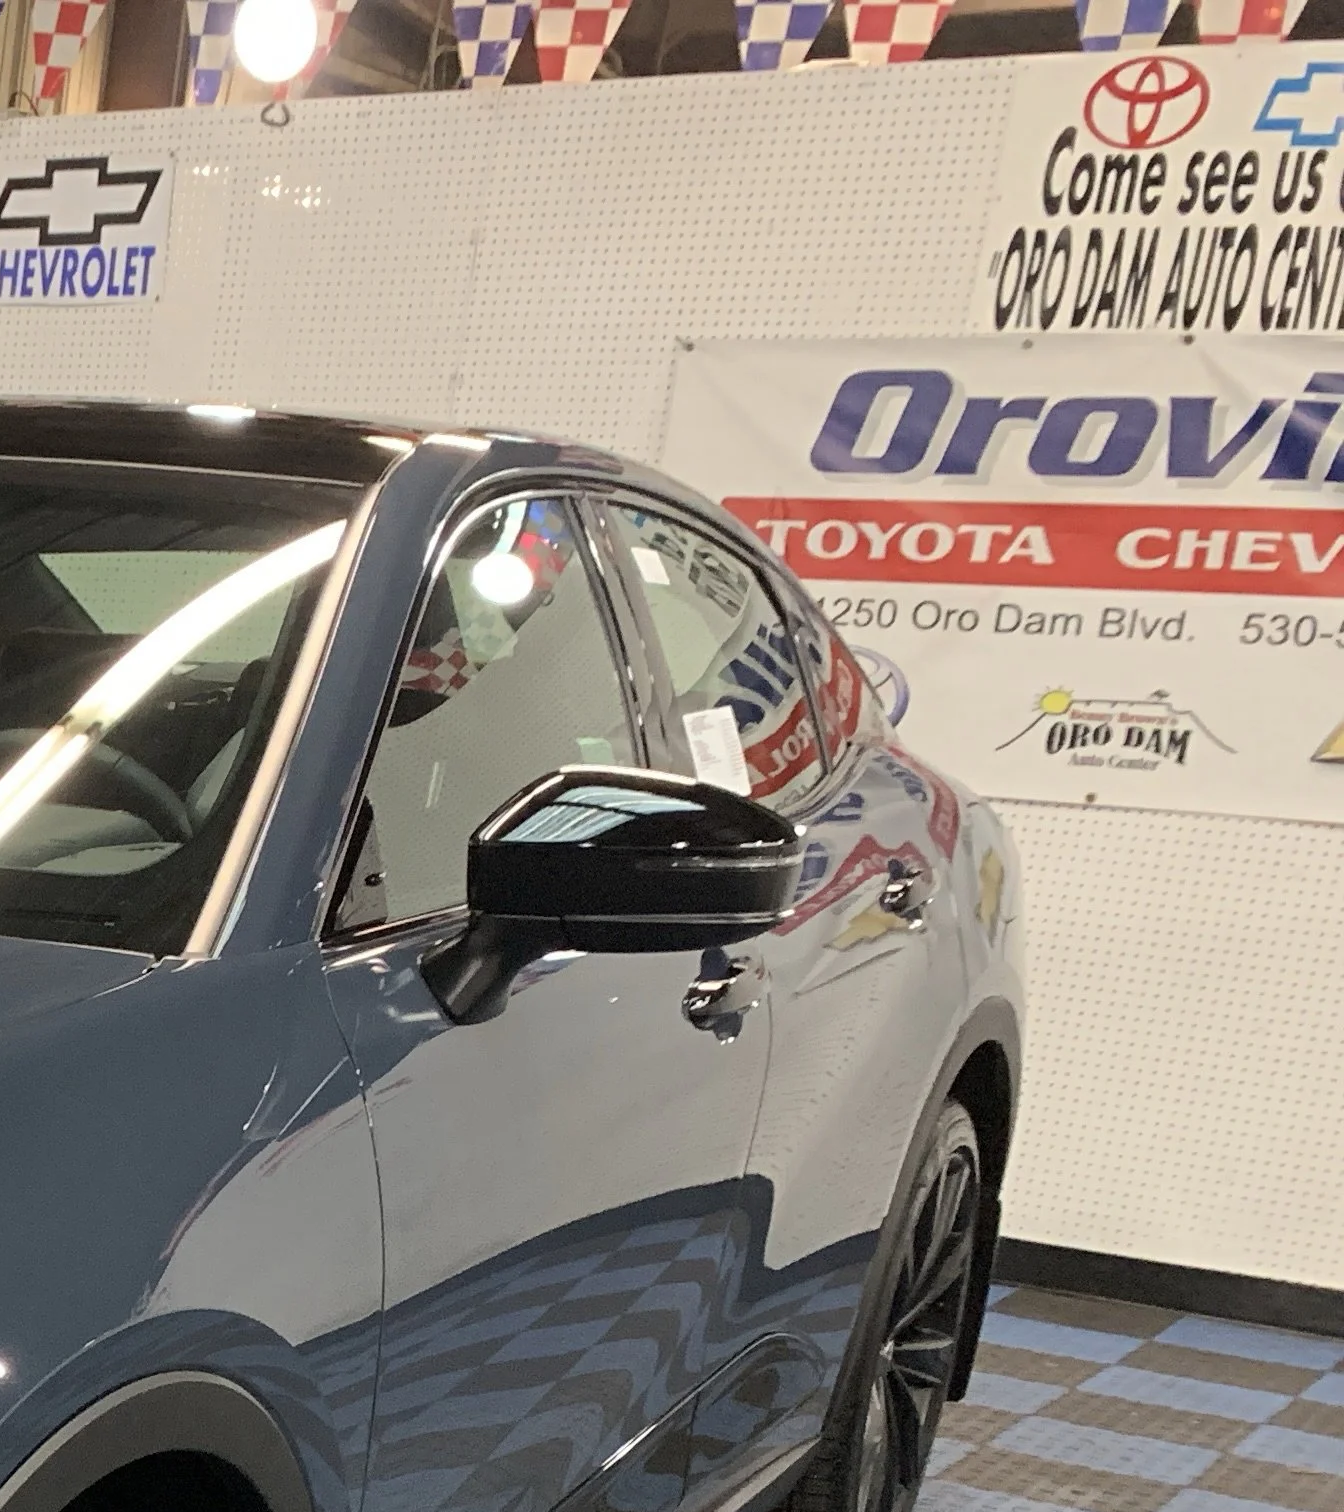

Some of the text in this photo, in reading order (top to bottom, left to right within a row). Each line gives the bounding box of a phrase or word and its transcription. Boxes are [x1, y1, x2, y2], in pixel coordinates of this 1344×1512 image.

[1042, 125, 1168, 217] Come
[1177, 150, 1261, 216] see
[1272, 149, 1329, 215] us
[1069, 227, 1161, 331] DAM
[1155, 223, 1259, 332] AUTO
[1260, 223, 1344, 332] CENT
[756, 519, 1344, 573] TOYOTA CHEV
[912, 600, 980, 632] Oro
[993, 603, 1084, 636] Dam
[1098, 606, 1196, 641] Blvd.
[1045, 720, 1193, 766] ORO DAM
